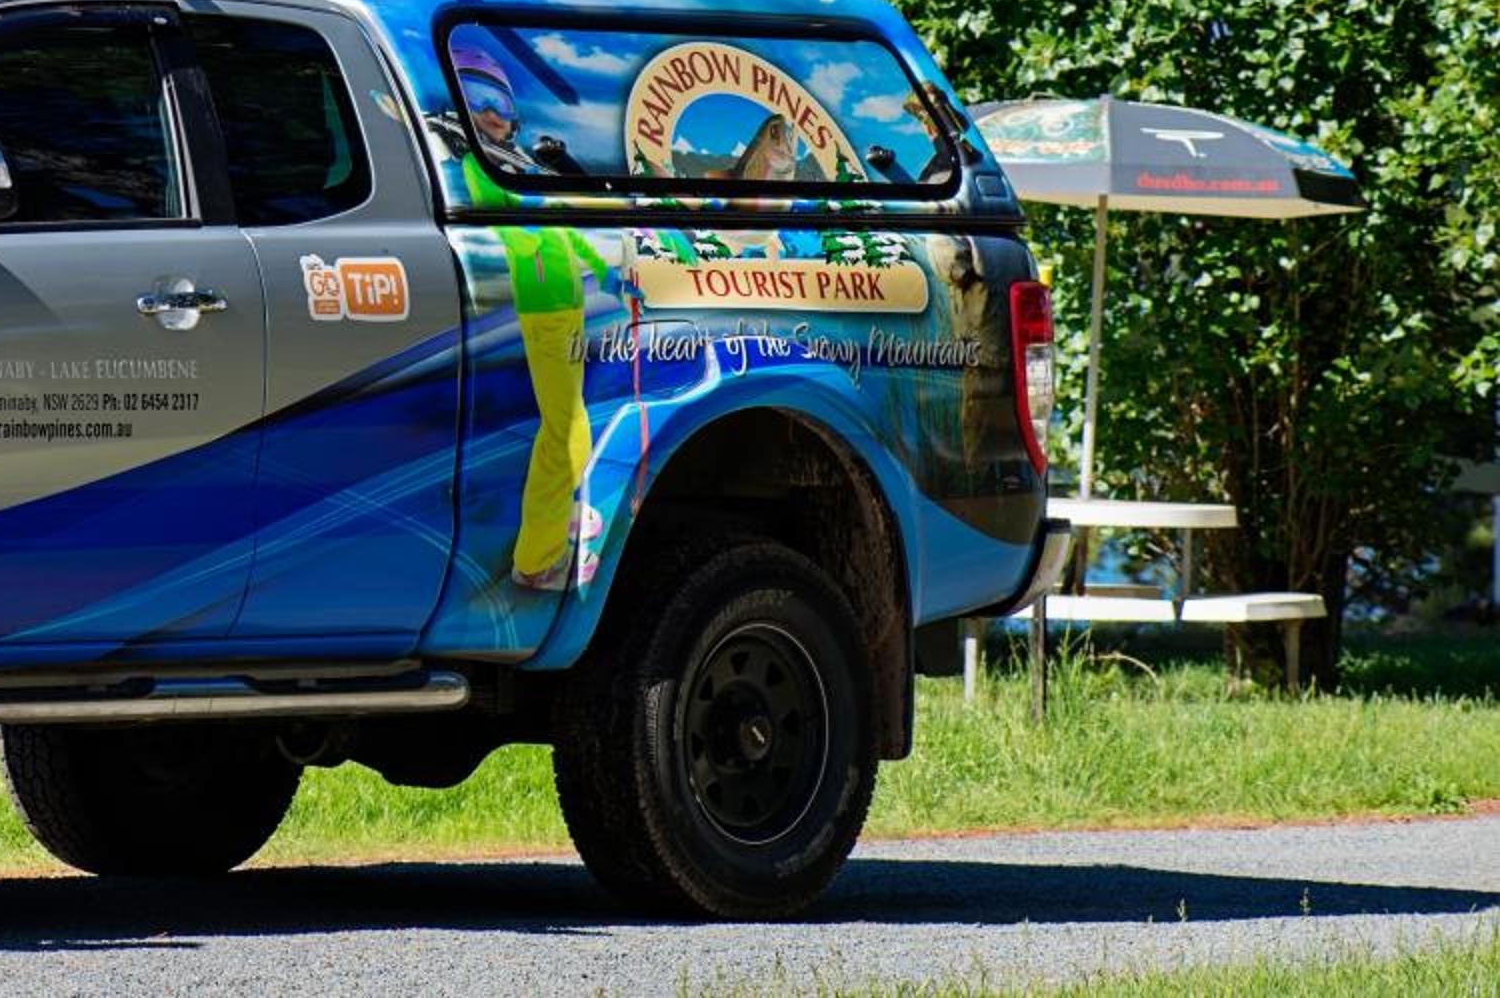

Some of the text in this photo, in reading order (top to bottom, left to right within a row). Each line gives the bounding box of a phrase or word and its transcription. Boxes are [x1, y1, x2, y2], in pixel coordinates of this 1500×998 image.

[638, 50, 833, 149] RAINBOW PINES
[687, 269, 885, 300] TOURIST PARK
[51, 360, 89, 379] LAKE
[96, 358, 197, 379] EUCUMBENE
[567, 317, 981, 390] in the heart of the Snowy Mountains
[43, 393, 68, 411] NSW
[102, 393, 120, 411] Ph:
[123, 393, 138, 411] 02
[141, 393, 169, 411] 6454
[172, 393, 199, 411] 2317
